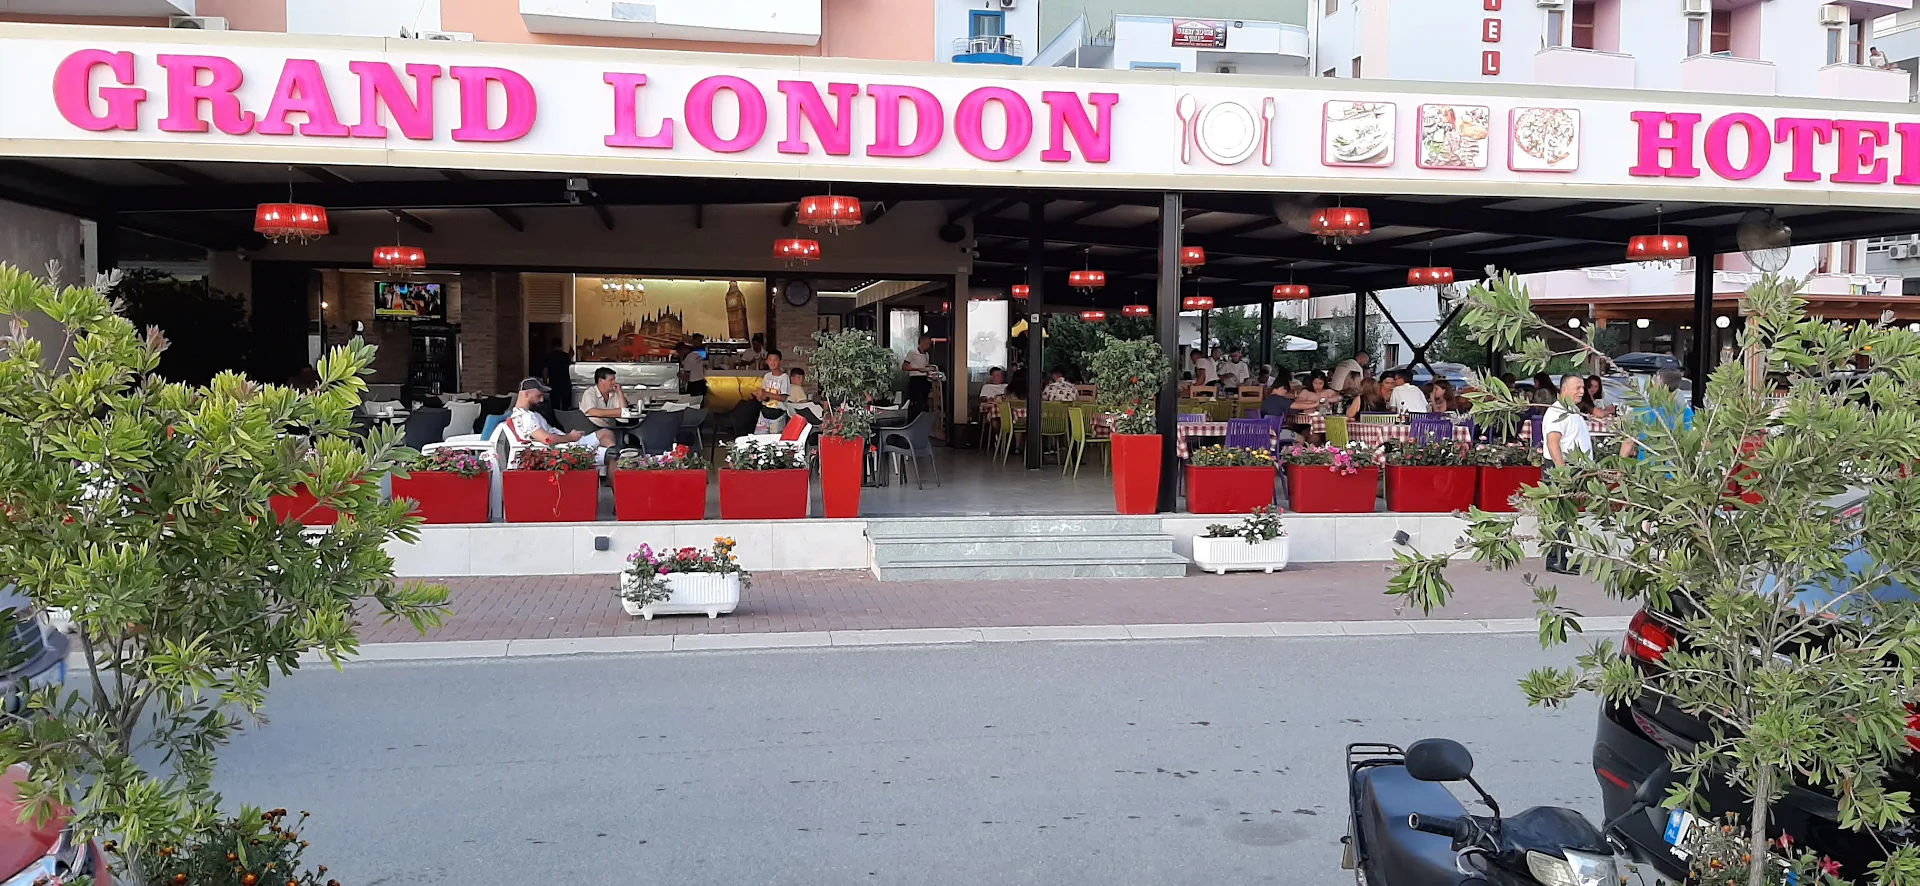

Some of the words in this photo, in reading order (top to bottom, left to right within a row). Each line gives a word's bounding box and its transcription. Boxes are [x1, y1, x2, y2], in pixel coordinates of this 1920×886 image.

[53, 48, 538, 143] GRAND
[602, 71, 1119, 163] LONDON
[1667, 828, 1676, 840] AL
